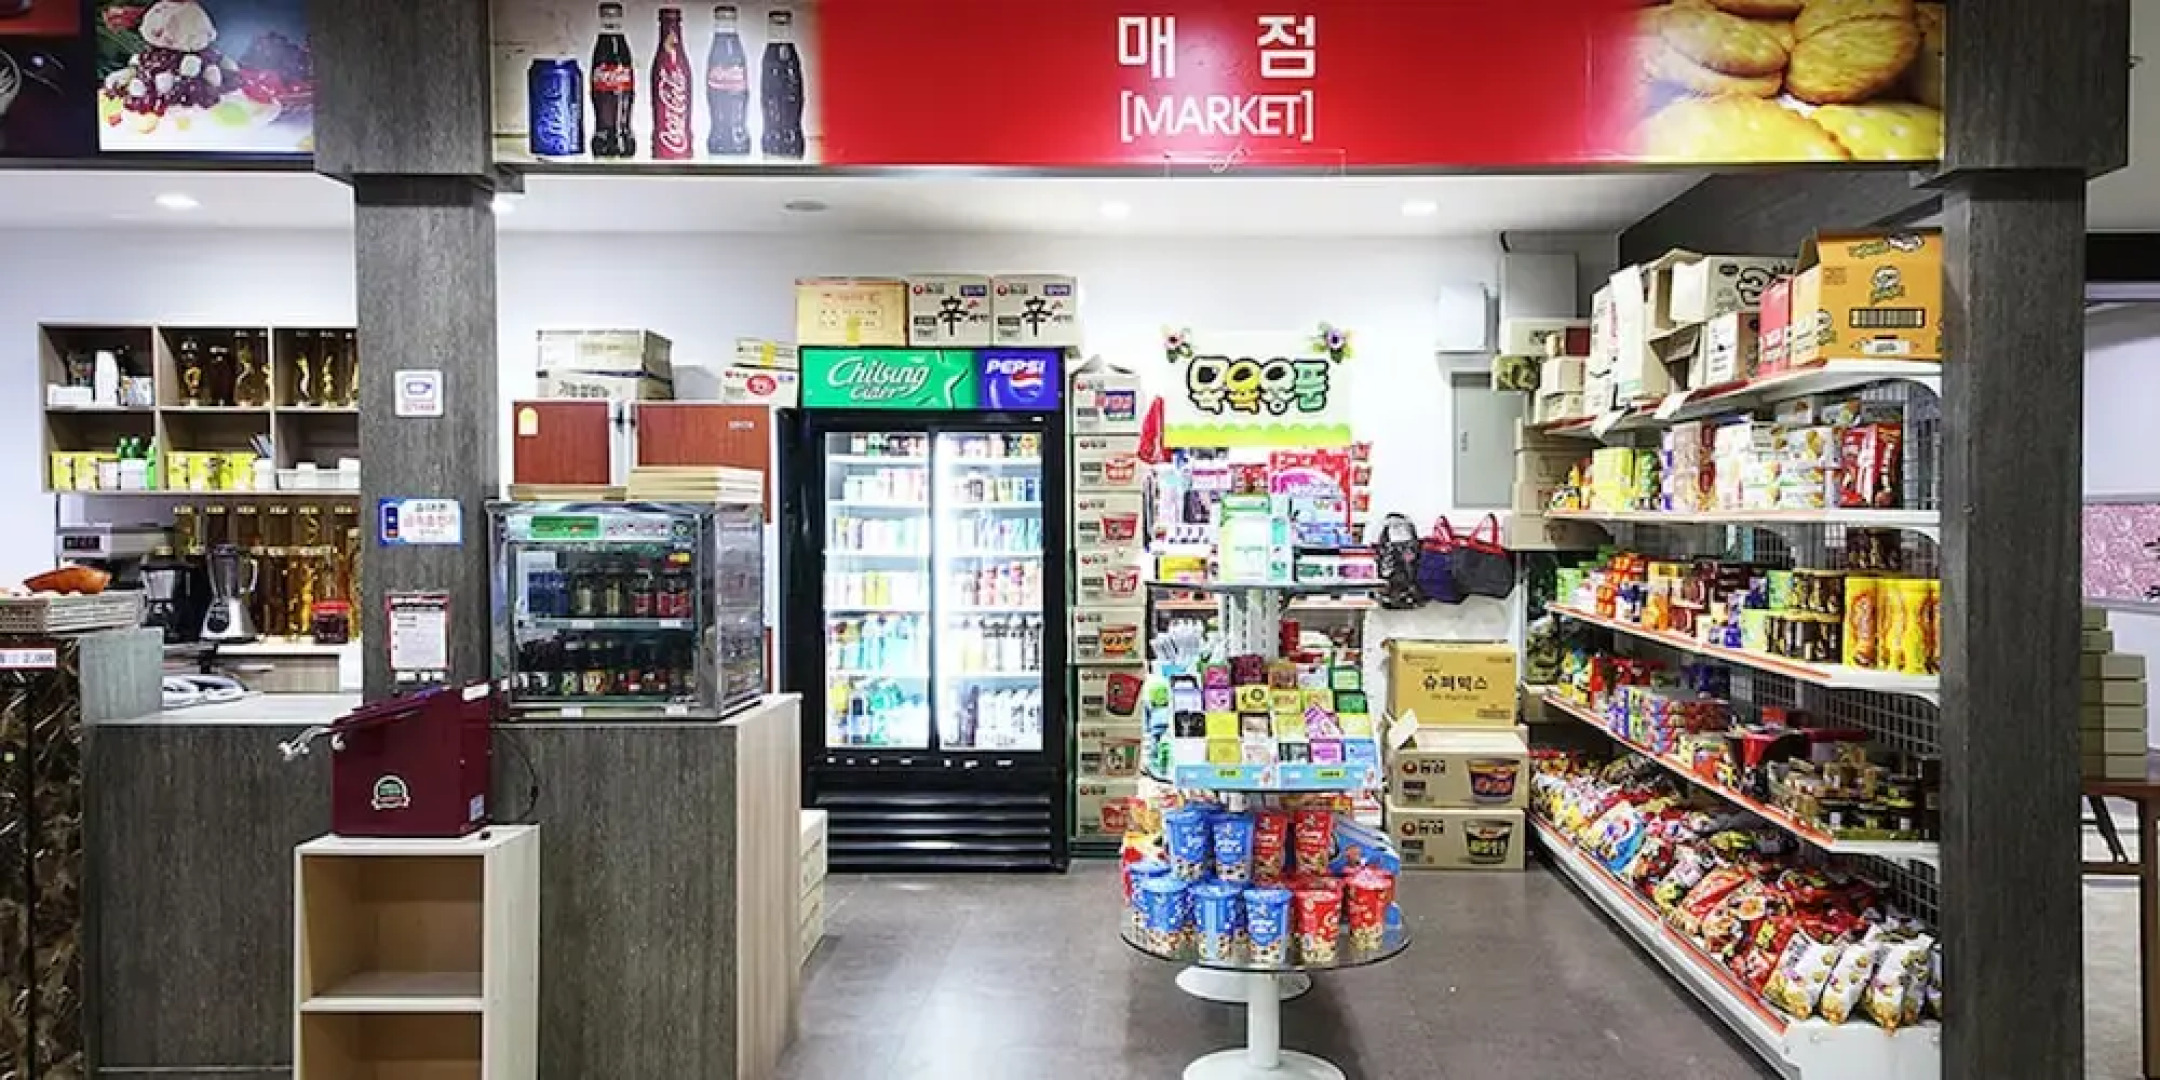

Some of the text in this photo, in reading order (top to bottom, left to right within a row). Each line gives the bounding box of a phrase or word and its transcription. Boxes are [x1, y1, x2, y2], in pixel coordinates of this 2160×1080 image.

[1118, 15, 1316, 79] 매 점
[985, 358, 1046, 374] PEPSI
